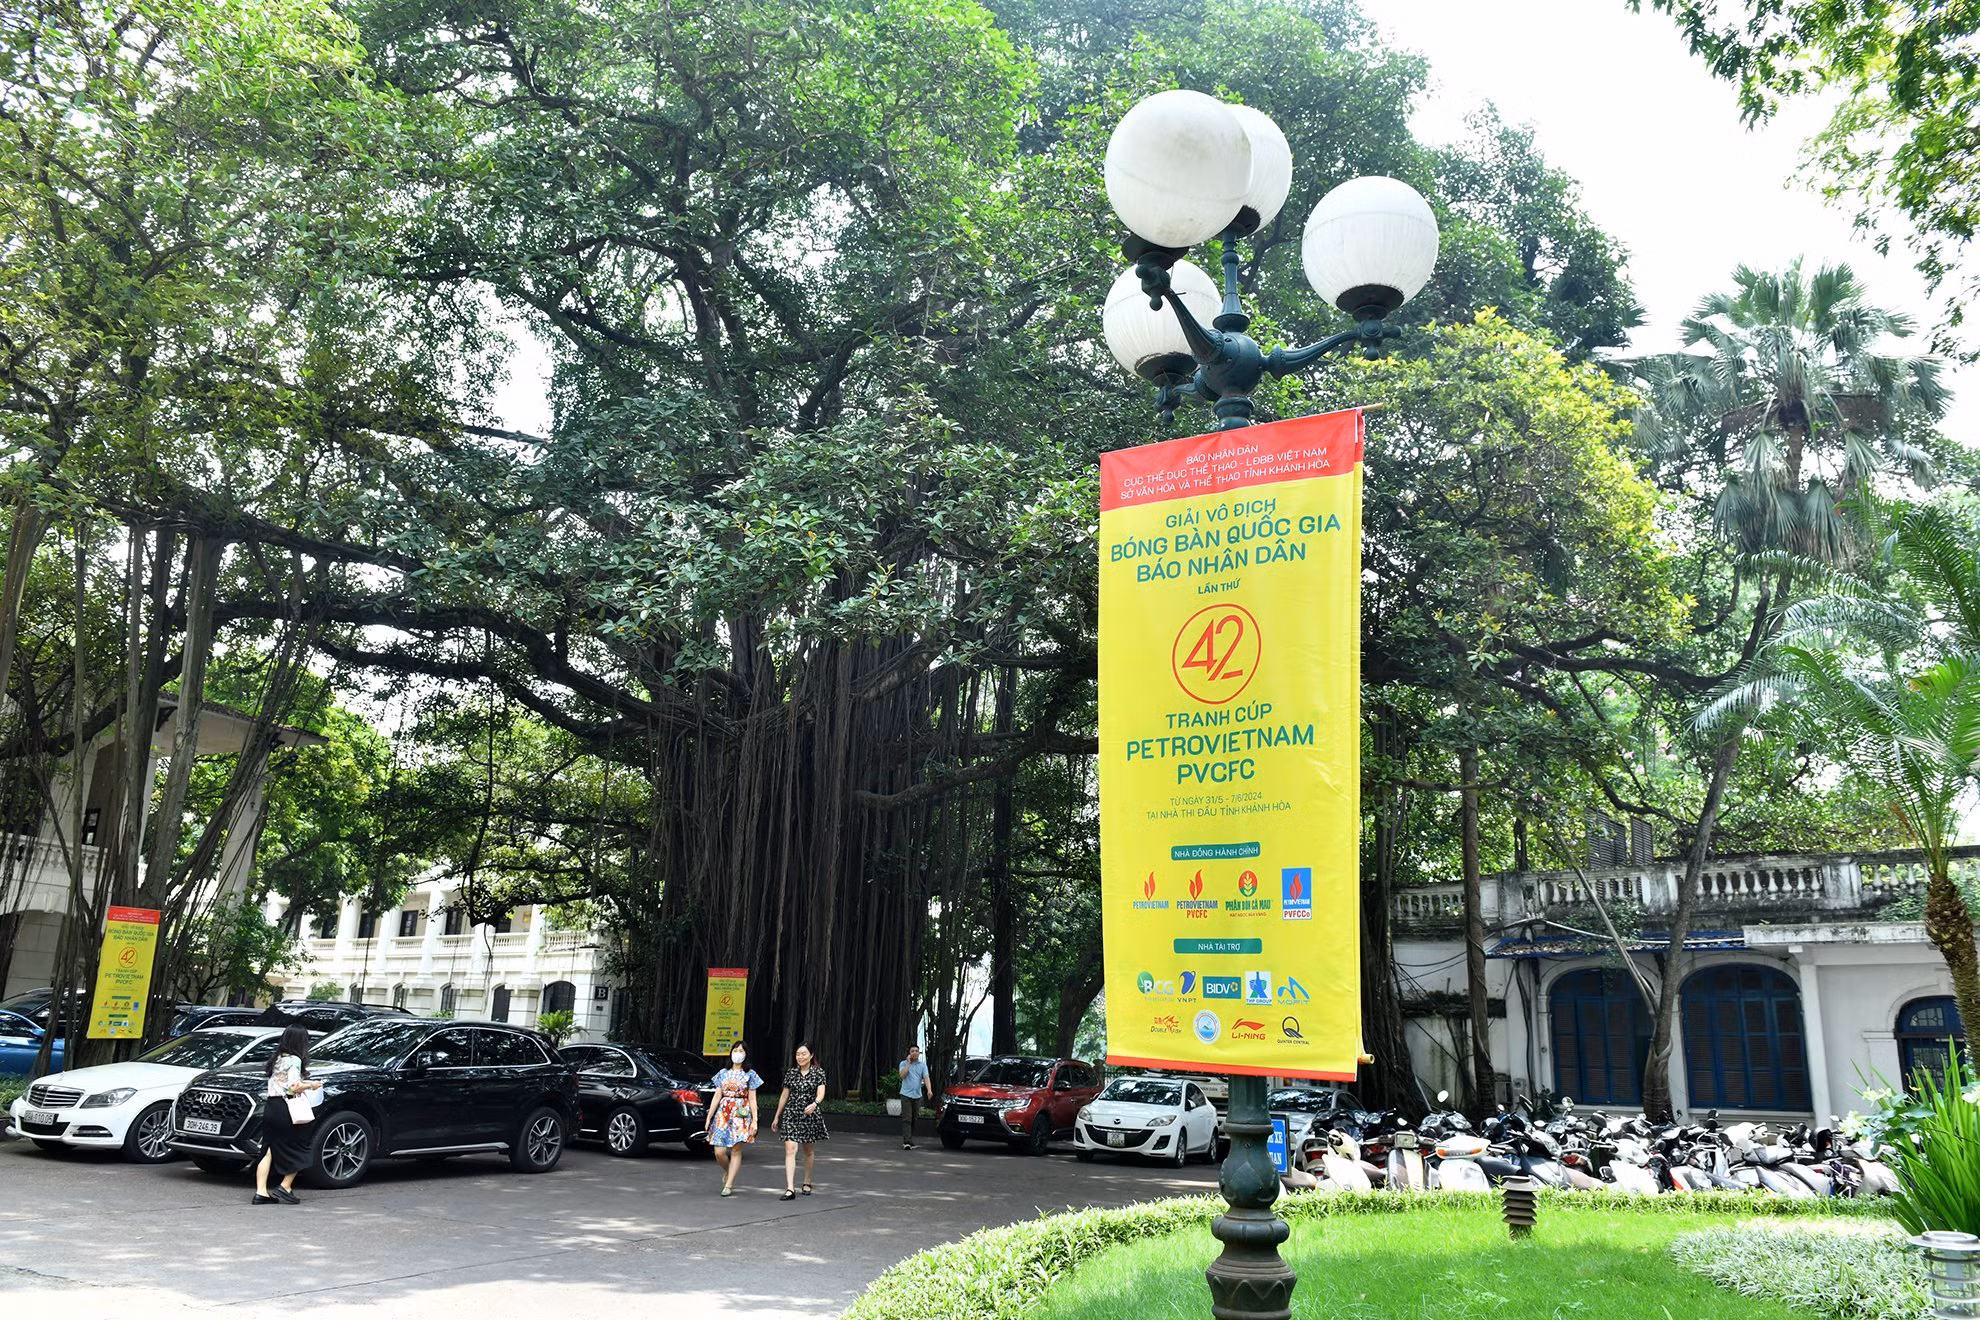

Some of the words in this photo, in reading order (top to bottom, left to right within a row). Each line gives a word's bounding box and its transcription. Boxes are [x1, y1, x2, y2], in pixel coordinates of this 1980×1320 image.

[1186, 452, 1206, 465] BÁO
[1208, 448, 1235, 460] NHÂN
[1237, 444, 1258, 456] DÂN
[1124, 476, 1144, 487] CỤC
[1146, 469, 1164, 483] THỂ
[1167, 469, 1188, 481] DỤC
[1190, 462, 1208, 475] THỂ
[1212, 460, 1237, 473] THAO
[1246, 454, 1275, 466] LĐBB
[1277, 449, 1300, 462] VIỆT
[1303, 447, 1327, 458] NAM
[1121, 487, 1134, 500] SỞ
[1136, 485, 1155, 497] VĂN
[1156, 482, 1176, 494] HÓA
[1179, 479, 1191, 490] VÀ
[1194, 474, 1212, 487] THỂ
[1216, 471, 1241, 484] THAO
[1243, 467, 1266, 479] TỈNH
[1269, 462, 1306, 475] KHÁNH
[1308, 458, 1330, 470] HÒA
[1166, 506, 1200, 528] GIẢI
[1207, 503, 1228, 523] VÔ
[1234, 498, 1276, 518] ĐỊCH
[1111, 535, 1168, 562] BÓNG
[1175, 527, 1220, 551] BÀN
[1227, 511, 1291, 543] QUỐC
[1299, 513, 1341, 535] GIA
[1137, 556, 1181, 582] BÁO
[1188, 548, 1248, 577] NHÂN
[1255, 539, 1306, 566] DÂN
[1221, 578, 1241, 591] THỨ
[1181, 614, 1244, 682] 42
[1166, 710, 1230, 730] TRANH
[1235, 700, 1272, 723] CÚP
[1126, 724, 1314, 761] PETROVIETNAM
[1177, 758, 1255, 785] PVCFC
[1170, 797, 1181, 806] TỪ
[1182, 795, 1204, 806] NGÀY
[1205, 795, 1224, 805] 31/5
[1231, 791, 1262, 804] 7/6/2024
[1146, 811, 1159, 822] TẠI
[1160, 808, 1178, 819] NHÀ
[1181, 809, 1195, 818] THI
[1197, 804, 1217, 818] ĐẤU
[1220, 804, 1240, 816] TỈNH
[1241, 801, 1270, 814] KHÁNH
[1272, 800, 1291, 811] HÒA
[1174, 848, 1190, 858] NHÀ
[1192, 847, 1213, 857] ĐỒNG
[1215, 846, 1237, 856] HÀNH
[1238, 845, 1259, 856] CHÍNH
[1133, 900, 1169, 909] PETROVIETNAM
[1176, 900, 1218, 909] PETROVIETNAM
[1186, 910, 1208, 919] PVCFC
[1198, 942, 1213, 950] NHÀ
[1215, 941, 1226, 950] TÀI
[1227, 942, 1241, 951] TRỢ
[121, 950, 135, 963] 42
[598, 988, 606, 998] B
[1143, 979, 1174, 995] BCG
[1206, 983, 1231, 994] BIDV
[1231, 1032, 1266, 1040] LI-NING
